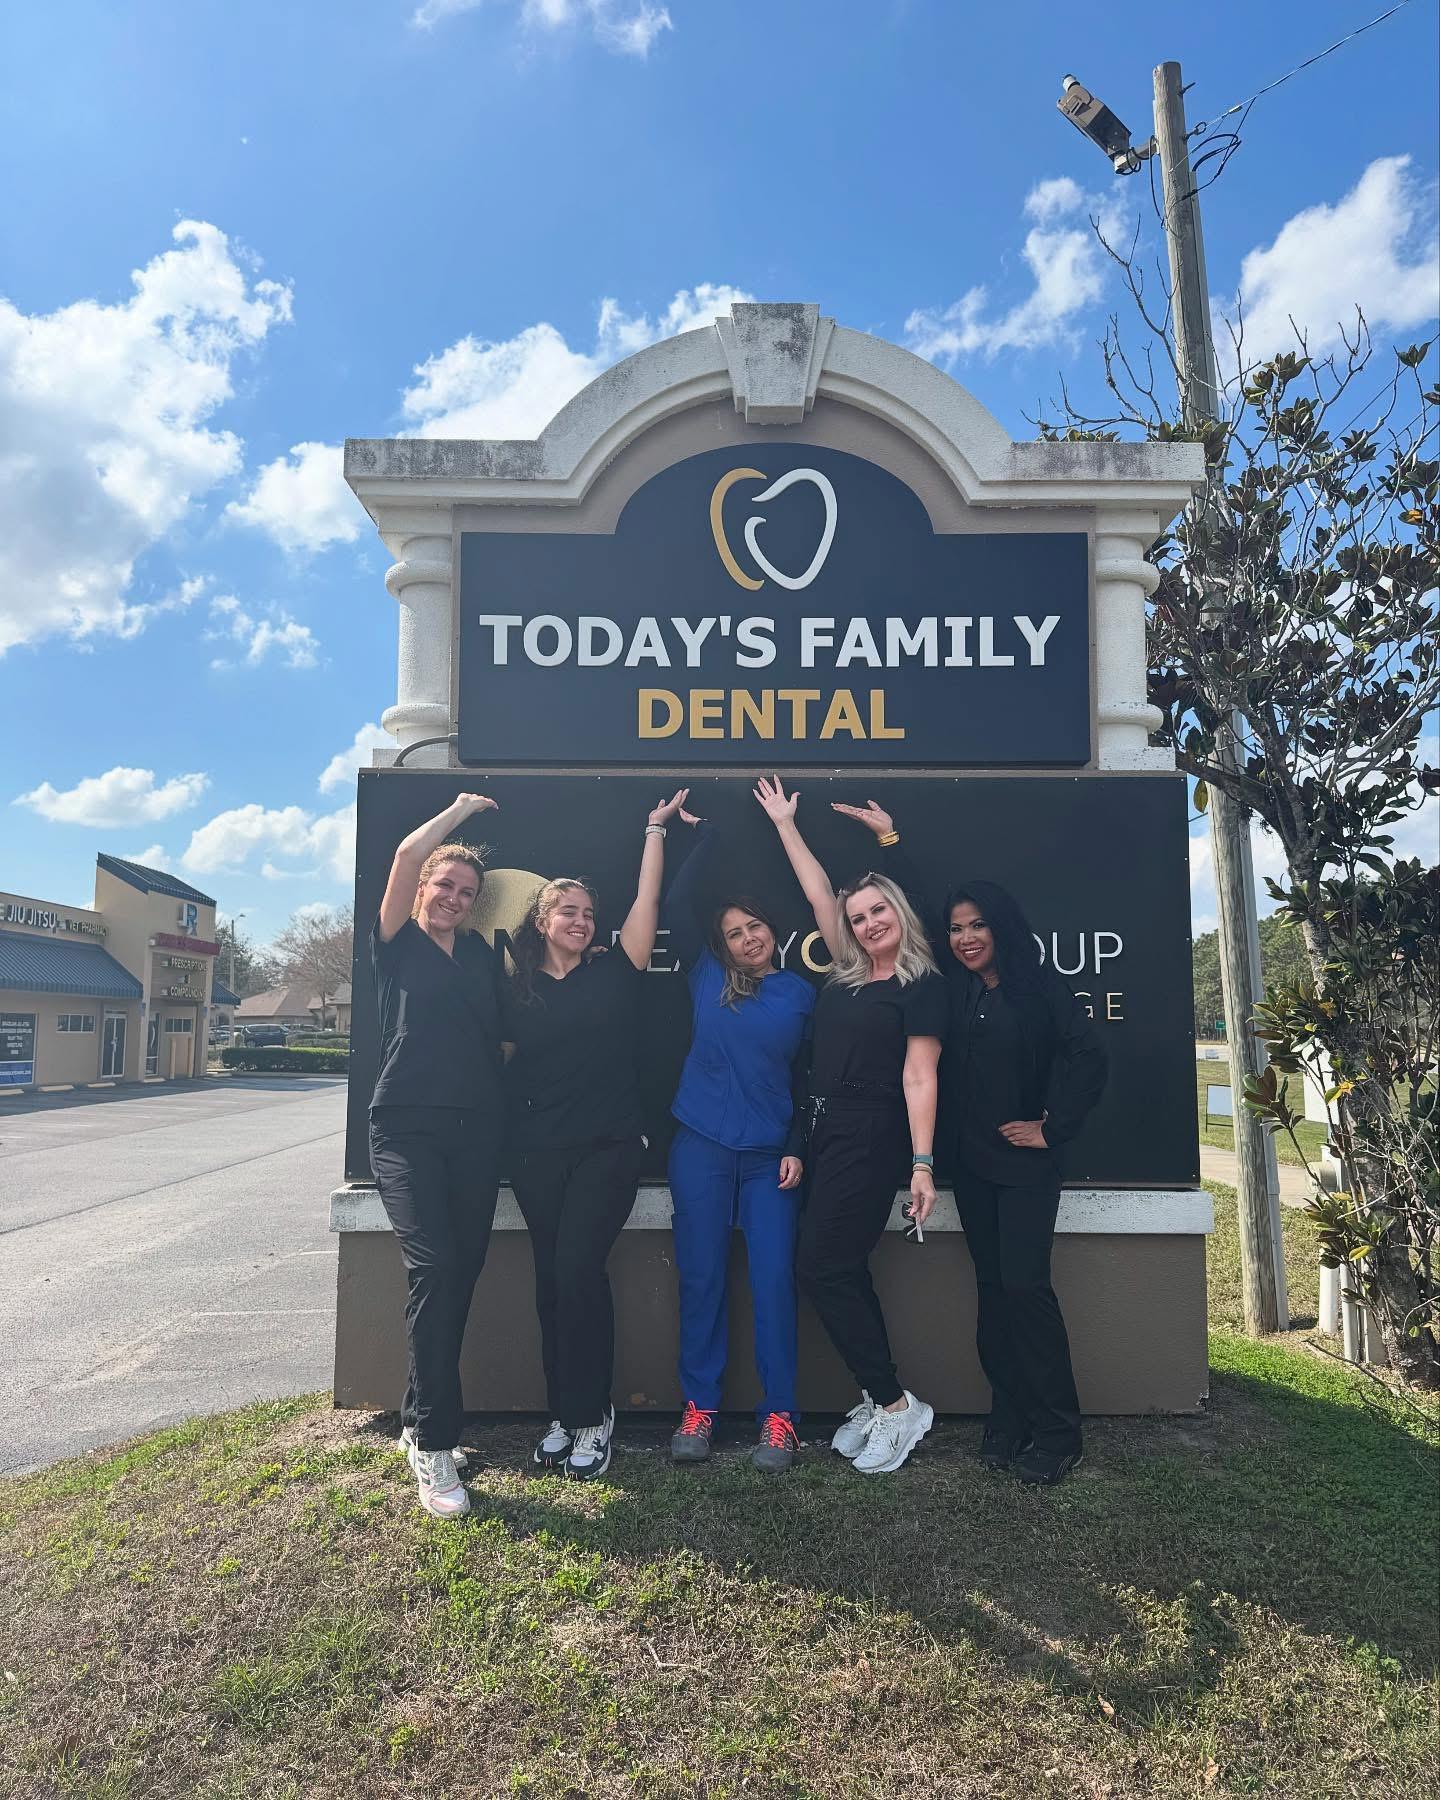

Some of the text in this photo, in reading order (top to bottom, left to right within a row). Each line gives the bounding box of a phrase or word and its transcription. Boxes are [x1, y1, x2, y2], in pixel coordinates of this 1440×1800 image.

[479, 615, 1061, 668] TODAY'S FAMILY
[637, 689, 906, 740] DENTAL
[8, 904, 25, 923] JIU
[28, 908, 56, 928] JITSU
